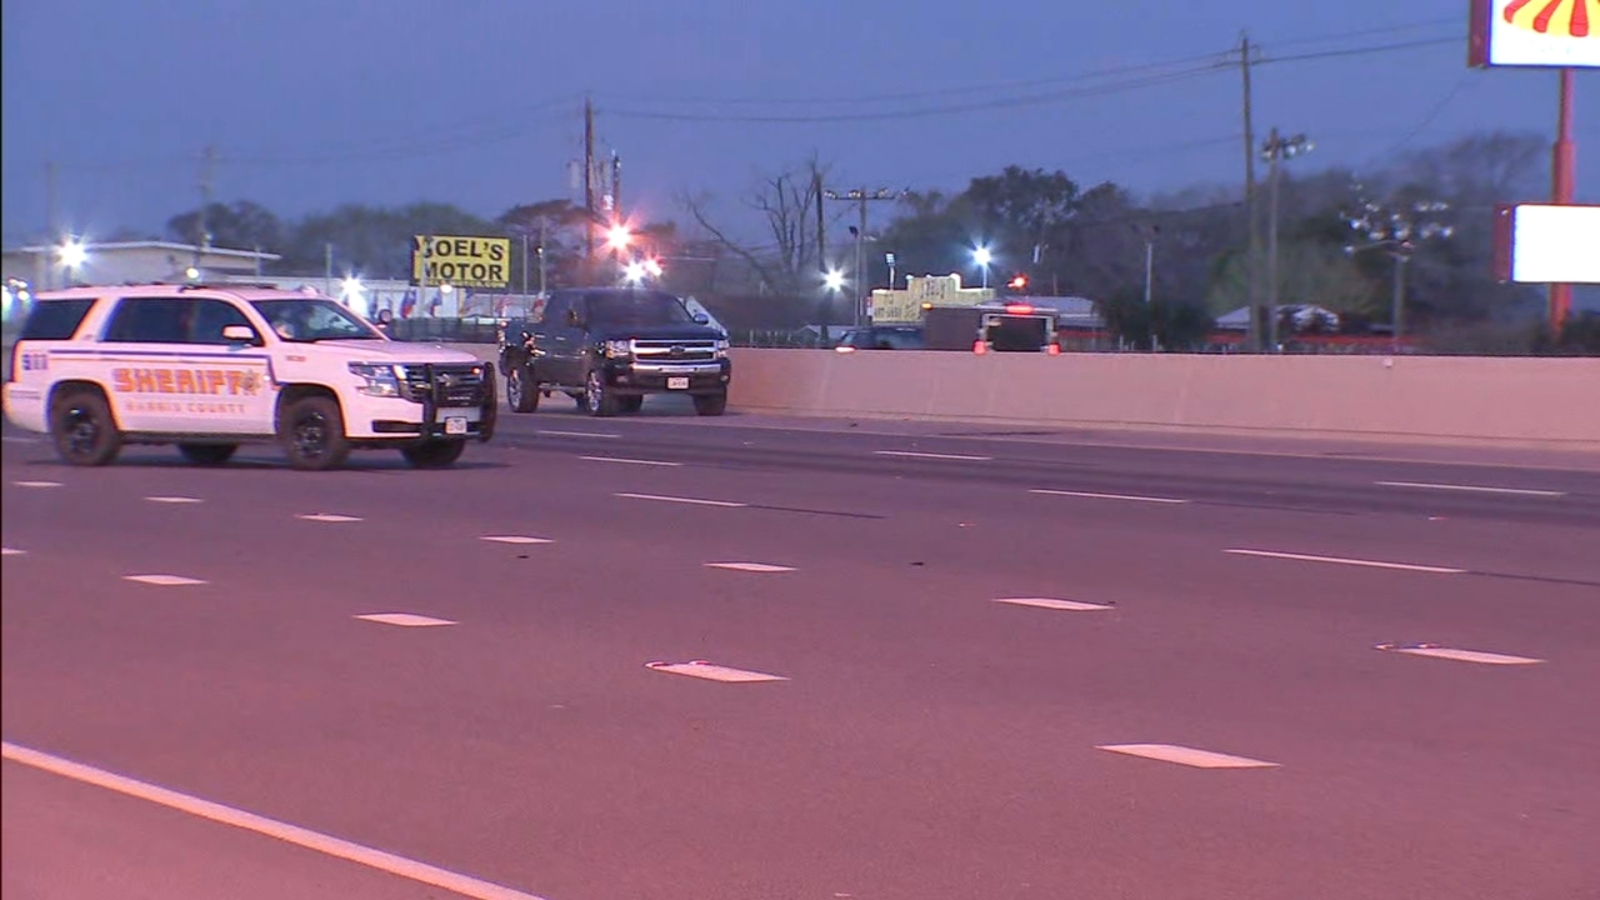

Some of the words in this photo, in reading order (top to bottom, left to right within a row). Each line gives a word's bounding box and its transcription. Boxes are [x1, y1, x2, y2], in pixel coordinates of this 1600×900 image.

[422, 261, 503, 280] MOTOR
[20, 353, 48, 371] 911
[112, 368, 247, 395] SHERIFF
[187, 402, 245, 414] COUNTY
